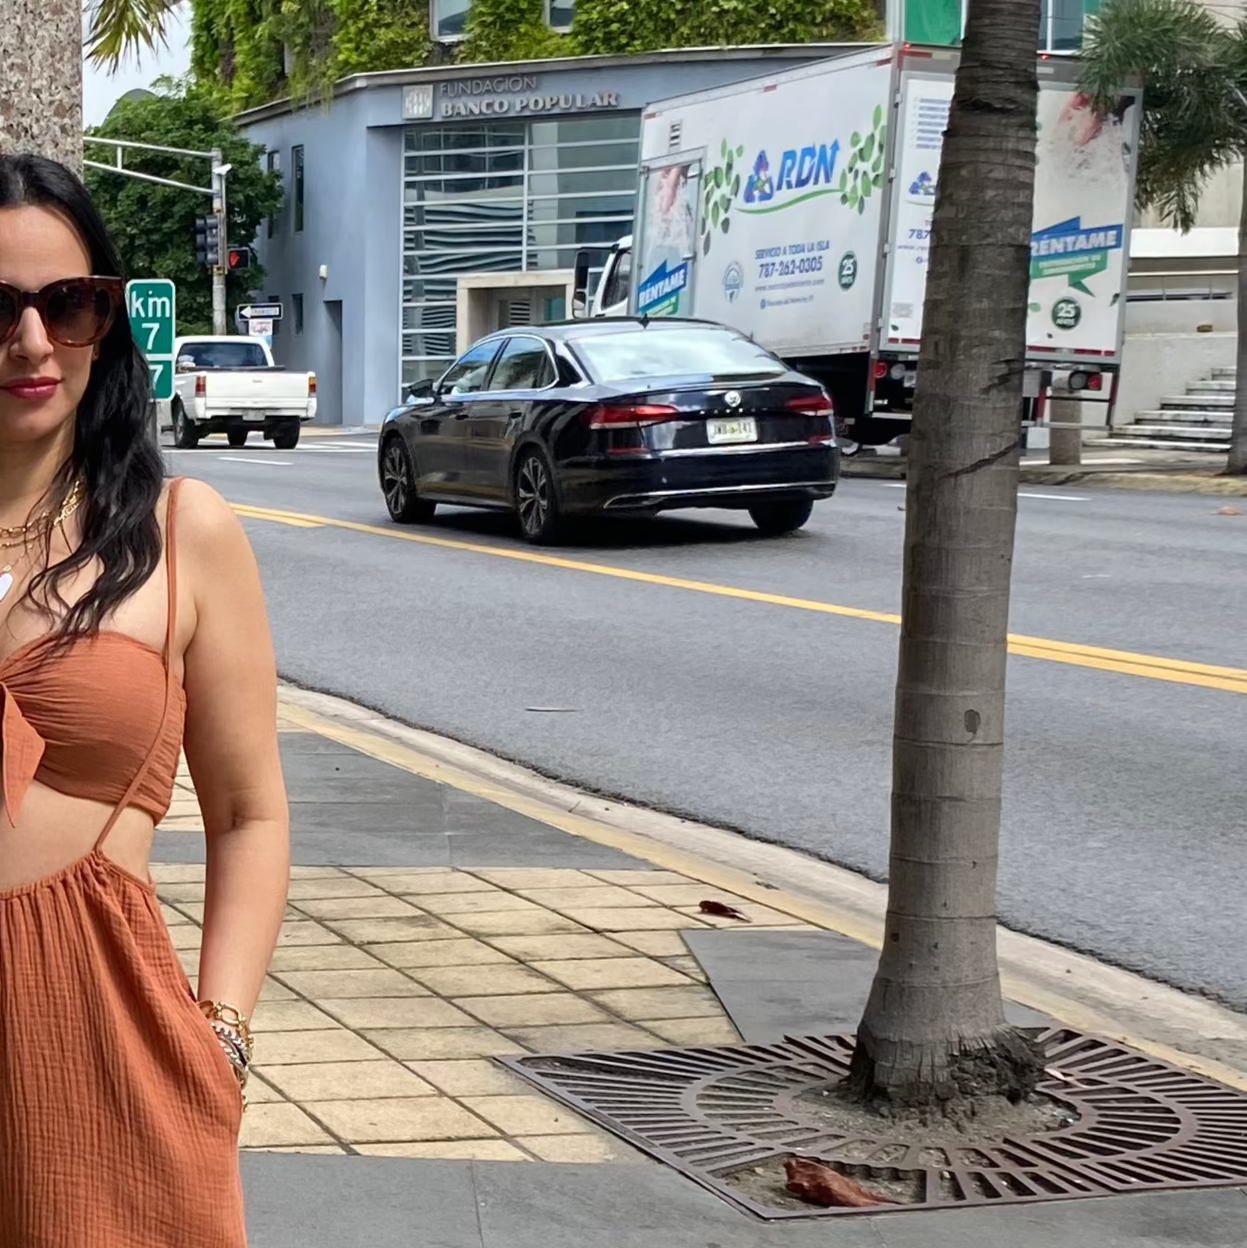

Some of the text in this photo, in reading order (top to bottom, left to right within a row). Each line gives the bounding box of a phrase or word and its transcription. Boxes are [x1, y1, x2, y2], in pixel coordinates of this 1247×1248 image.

[440, 92, 619, 118] BANCO POPULAR
[776, 138, 840, 192] RDN
[909, 229, 931, 239] 787
[759, 255, 823, 279] 787-262-0305
[131, 290, 170, 318] km
[1057, 302, 1076, 317] 25
[141, 322, 160, 350] 7
[148, 364, 164, 392] 7
